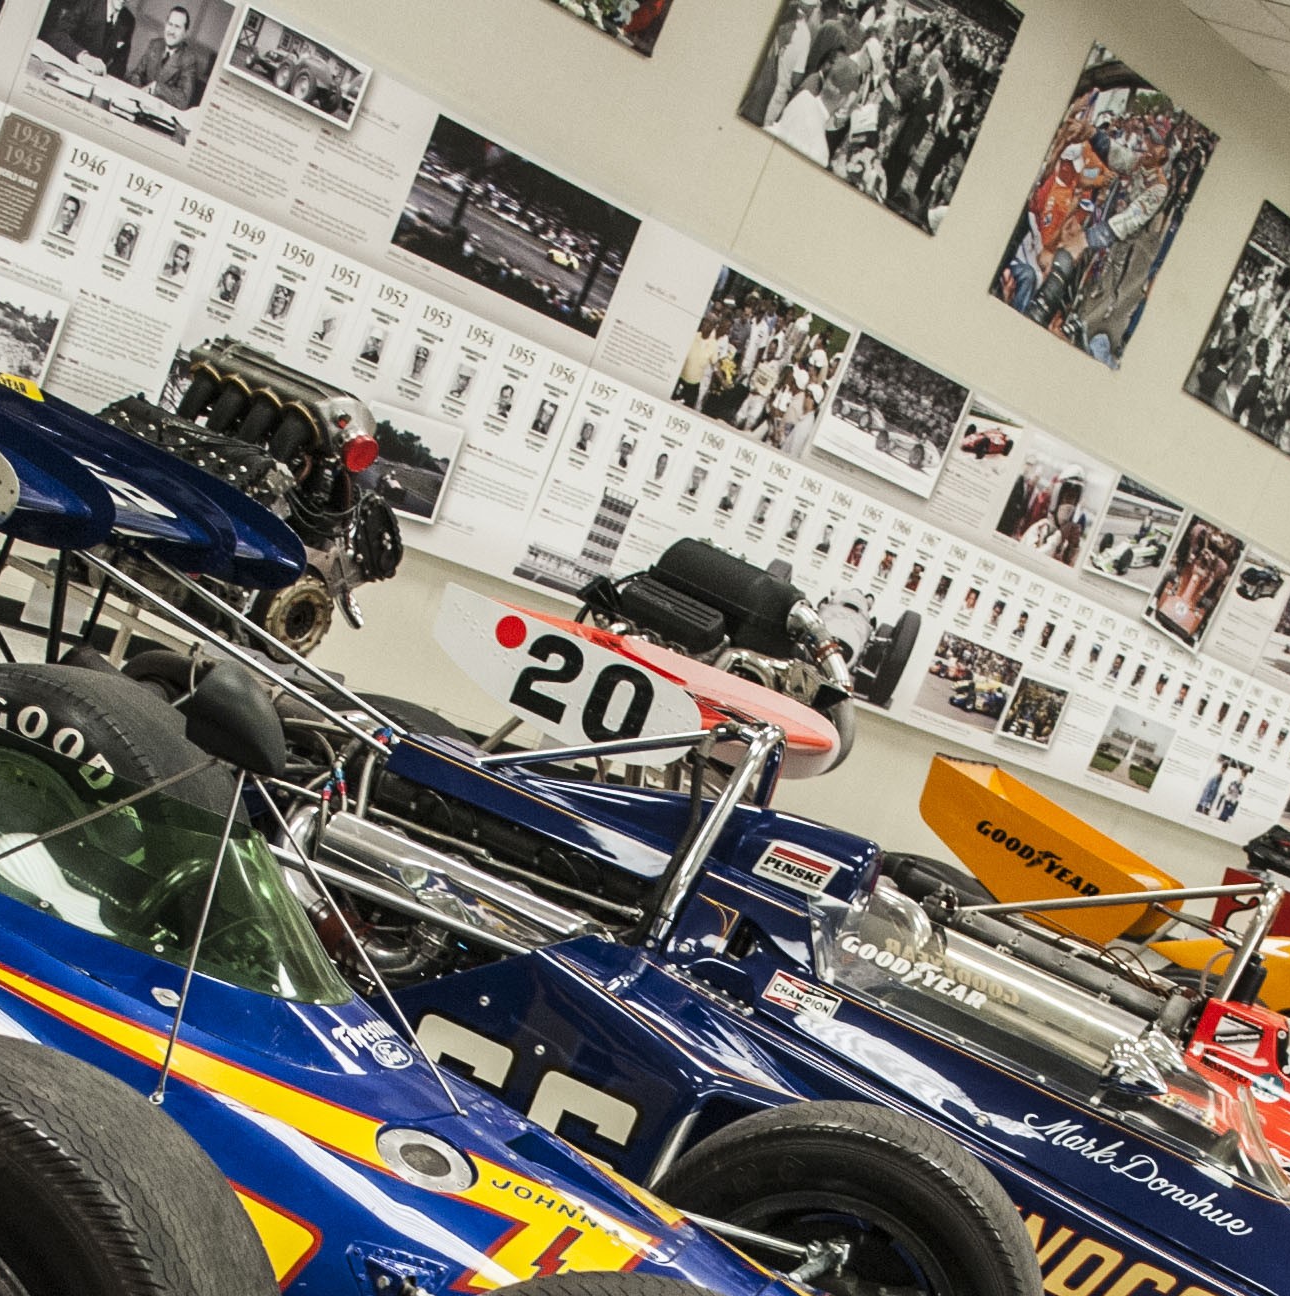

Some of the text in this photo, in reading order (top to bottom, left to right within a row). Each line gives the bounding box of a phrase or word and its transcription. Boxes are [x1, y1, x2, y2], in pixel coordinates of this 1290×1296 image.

[10, 121, 52, 152] 1942
[3, 145, 44, 176] 1945
[69, 147, 109, 177] 1946
[125, 172, 163, 199] 1947
[179, 197, 216, 224] 1948
[231, 219, 267, 246] 1949
[281, 242, 316, 268] 1950
[330, 263, 362, 289] 1951
[377, 283, 410, 309] 1952
[422, 304, 453, 329] 1953
[466, 324, 495, 348] 1954
[508, 343, 537, 367] 1955
[548, 361, 576, 385] 1956
[590, 380, 619, 401] 1957
[629, 398, 656, 420] 1958
[665, 415, 692, 435] 1959
[700, 431, 725, 451] 1960
[734, 446, 759, 466] 1961
[768, 461, 792, 481] 1962
[509, 633, 655, 744] 20
[763, 856, 826, 886] PENSKE
[975, 819, 1102, 899] GOODYEAR
[841, 936, 988, 1010] GOODYEAR
[773, 982, 831, 1014] CHAMPION
[1023, 1111, 1254, 1237] Mark Donohue
